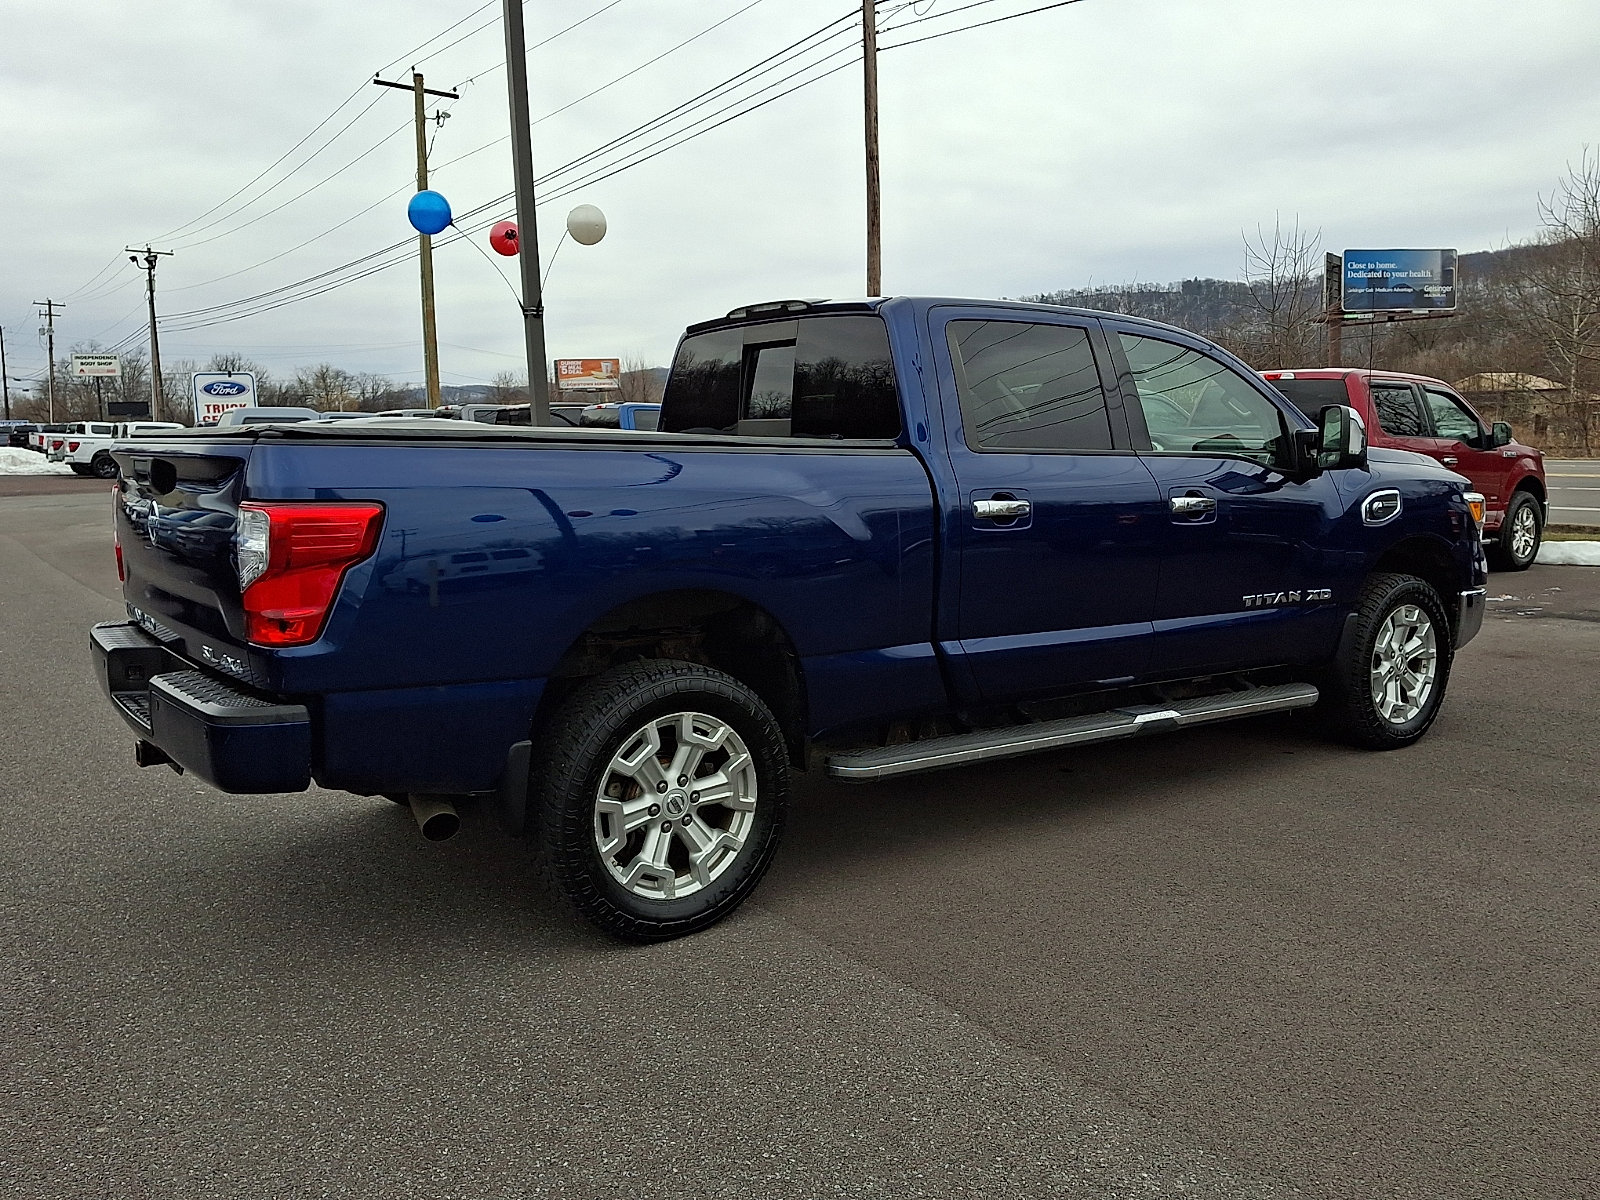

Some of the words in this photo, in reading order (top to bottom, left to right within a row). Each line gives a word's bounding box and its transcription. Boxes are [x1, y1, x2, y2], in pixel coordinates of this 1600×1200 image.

[1347, 261, 1366, 269] Close
[1376, 261, 1398, 269] home.
[1347, 270, 1382, 278] Dedicated
[1391, 271, 1408, 279] your
[1409, 269, 1433, 278] health.
[1423, 284, 1453, 293] Geisinger
[210, 383, 239, 395] Ford
[1243, 590, 1301, 607] TITAN
[1306, 588, 1332, 601] XD
